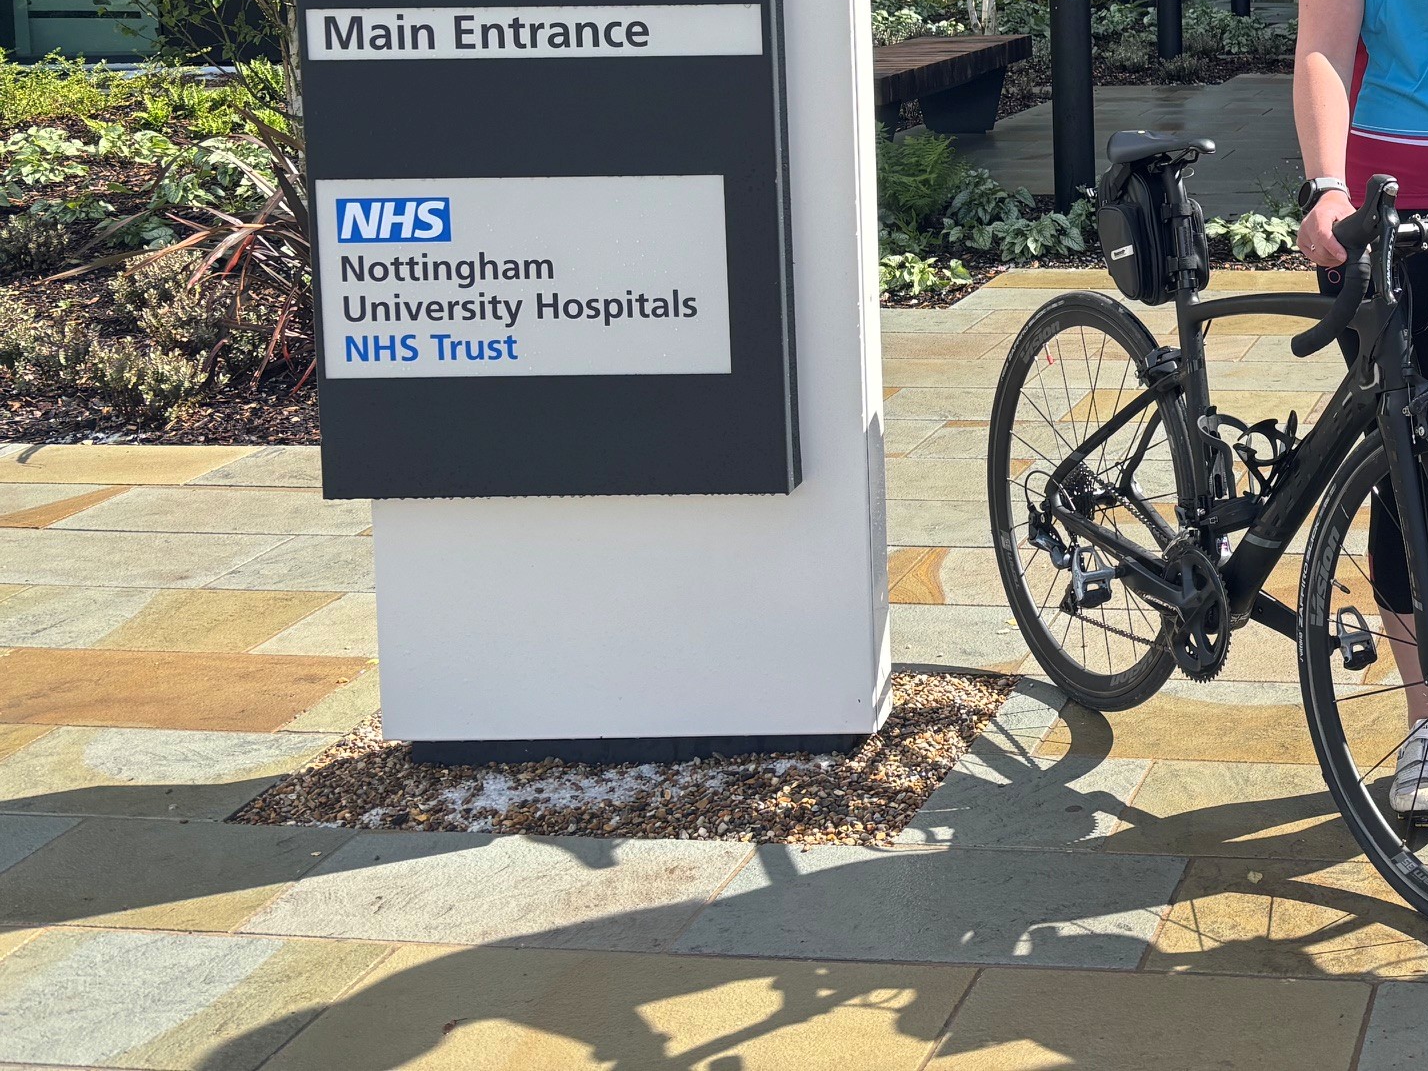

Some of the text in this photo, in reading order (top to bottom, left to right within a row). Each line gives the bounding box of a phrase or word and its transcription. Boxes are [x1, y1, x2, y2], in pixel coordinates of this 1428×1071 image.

[323, 14, 650, 51] Main Entrance
[340, 200, 446, 240] NHS
[340, 253, 555, 289] Nottingham
[342, 289, 698, 328] University Hospitals
[345, 333, 518, 362] NHS Trust
